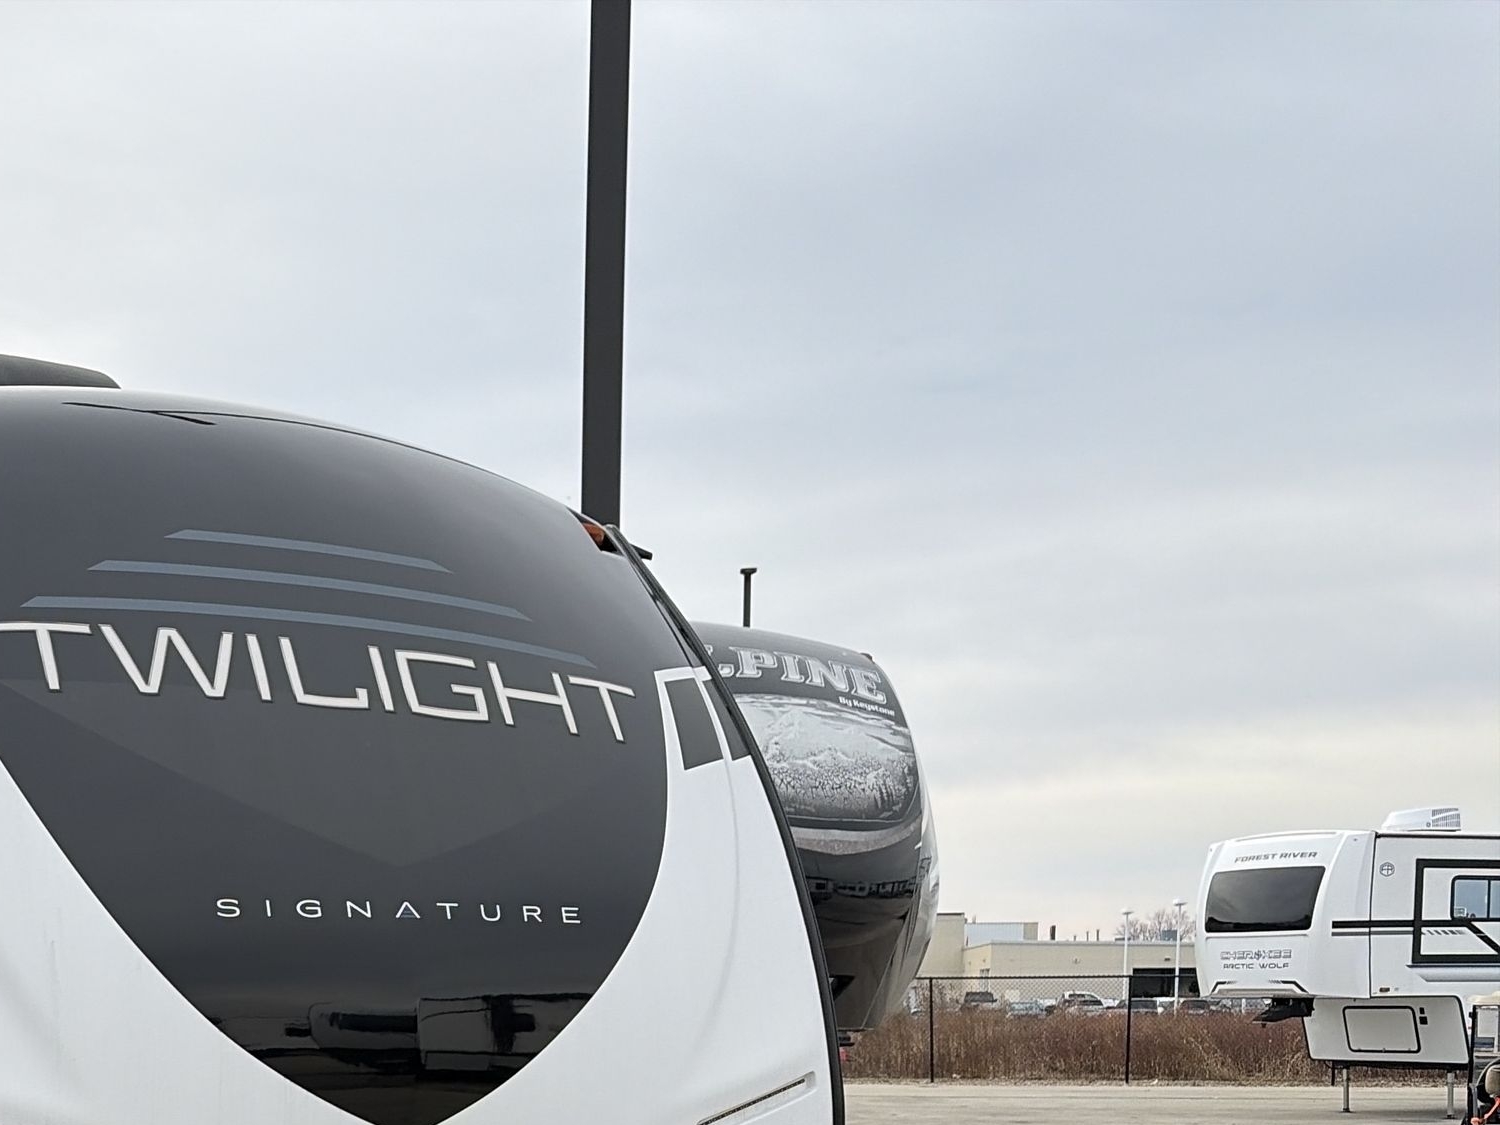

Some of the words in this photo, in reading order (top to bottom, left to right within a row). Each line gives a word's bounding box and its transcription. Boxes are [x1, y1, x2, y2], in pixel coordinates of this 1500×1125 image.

[1234, 853, 1278, 863] FOREST
[1279, 851, 1318, 860] RIVER
[216, 898, 581, 924] SIGNATURE
[1223, 962, 1255, 970] ARCTIC
[1259, 962, 1290, 970] WOLF
